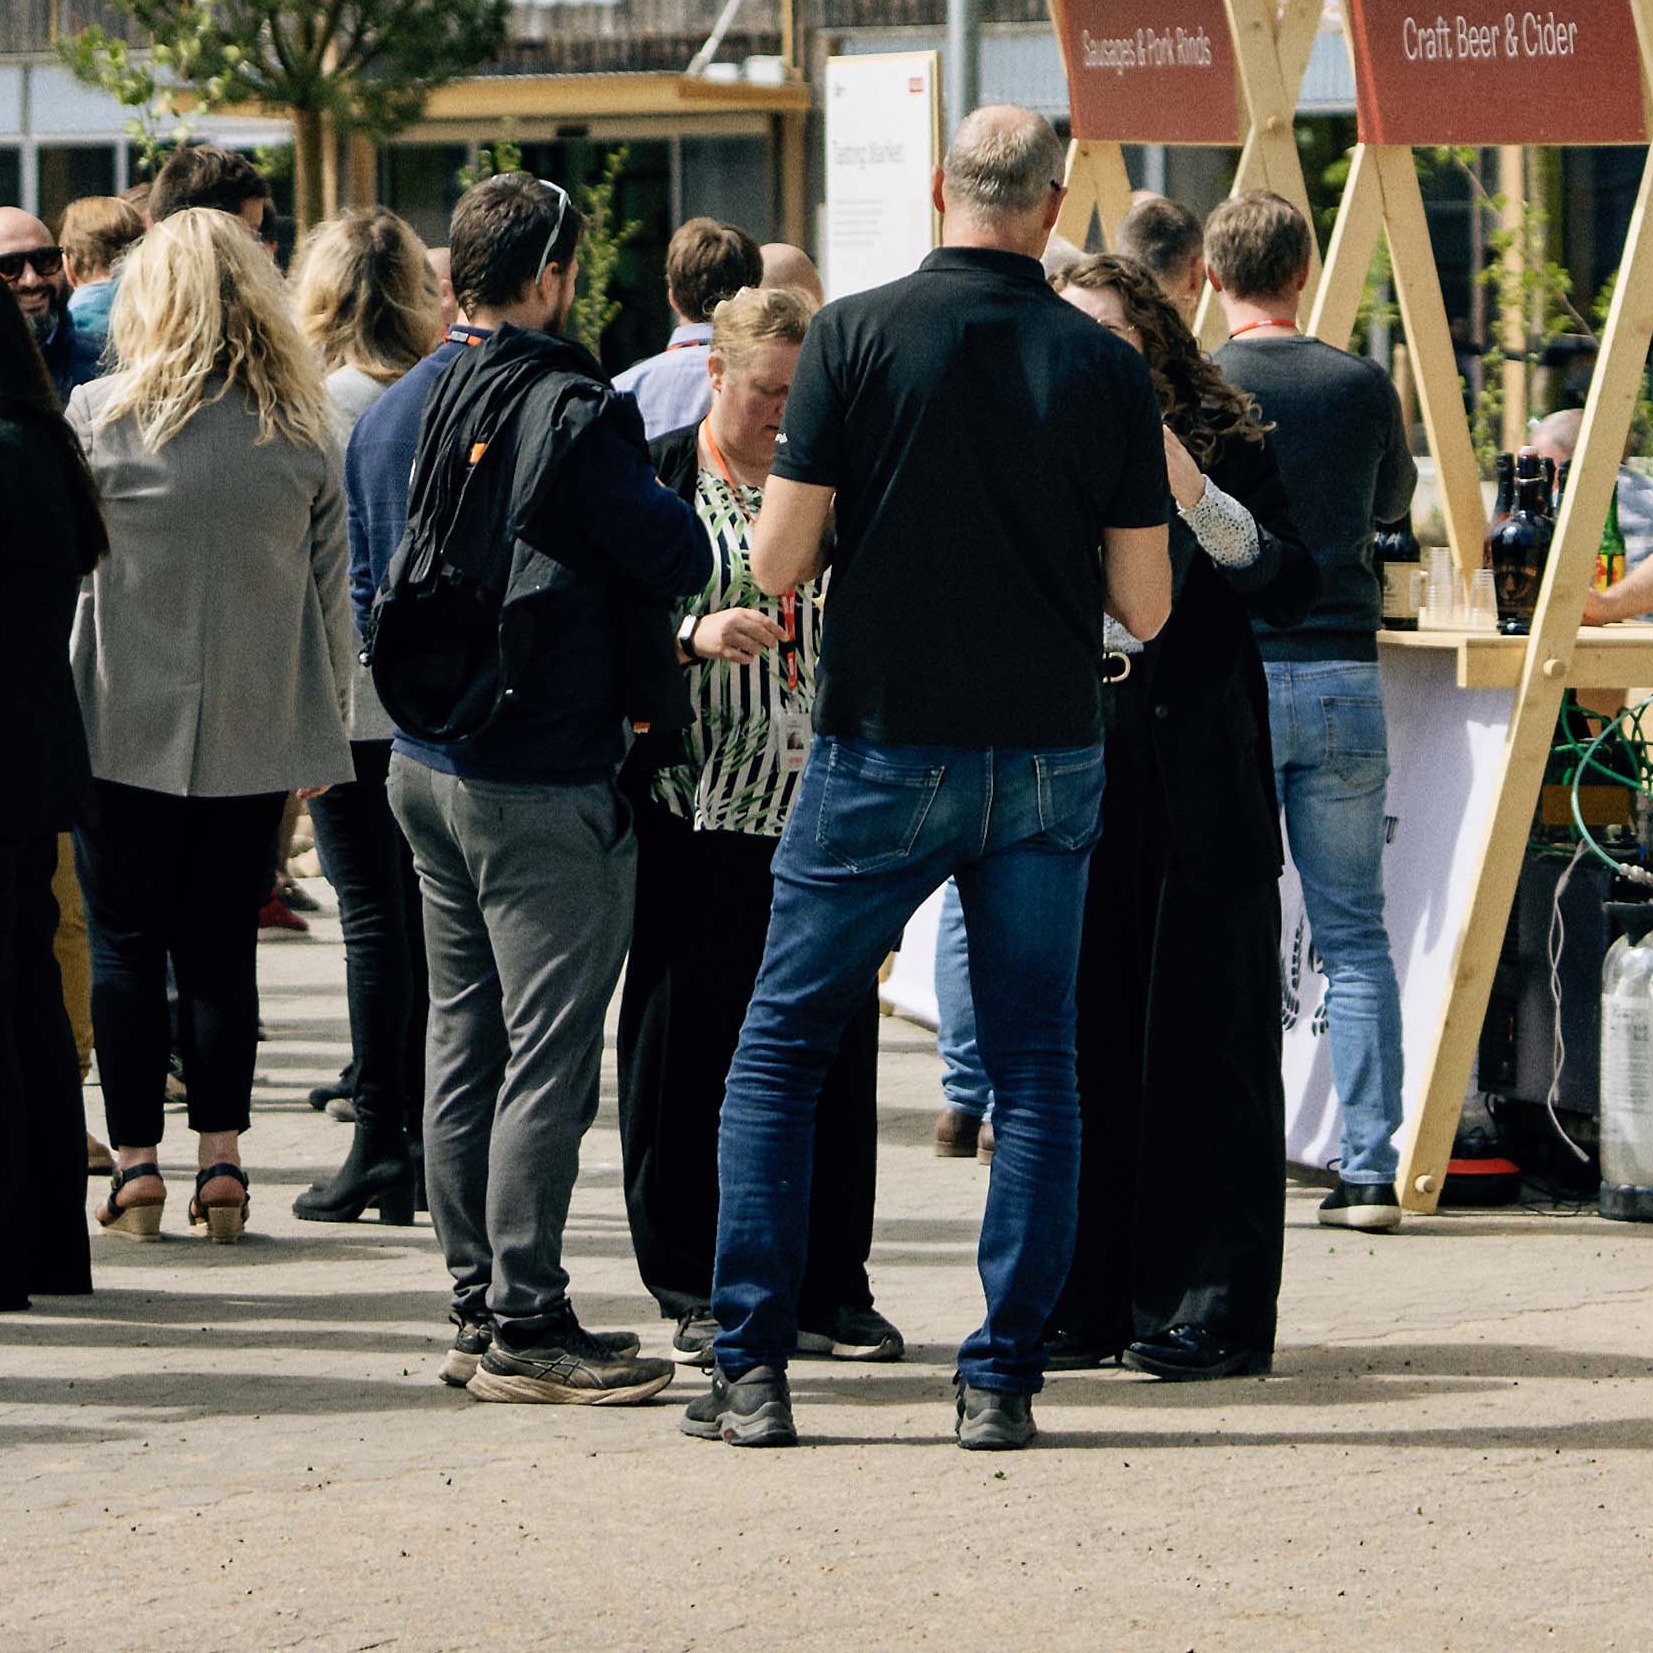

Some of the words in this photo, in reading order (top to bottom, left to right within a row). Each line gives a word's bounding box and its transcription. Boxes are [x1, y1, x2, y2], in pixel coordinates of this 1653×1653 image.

[1082, 29, 1136, 76] Sausages
[1146, 27, 1175, 66] Pork
[1175, 26, 1211, 65] Rinds
[1403, 16, 1453, 60] Craft
[1456, 15, 1500, 58] Beer
[1505, 12, 1519, 57] &
[1522, 11, 1578, 56] Cider
